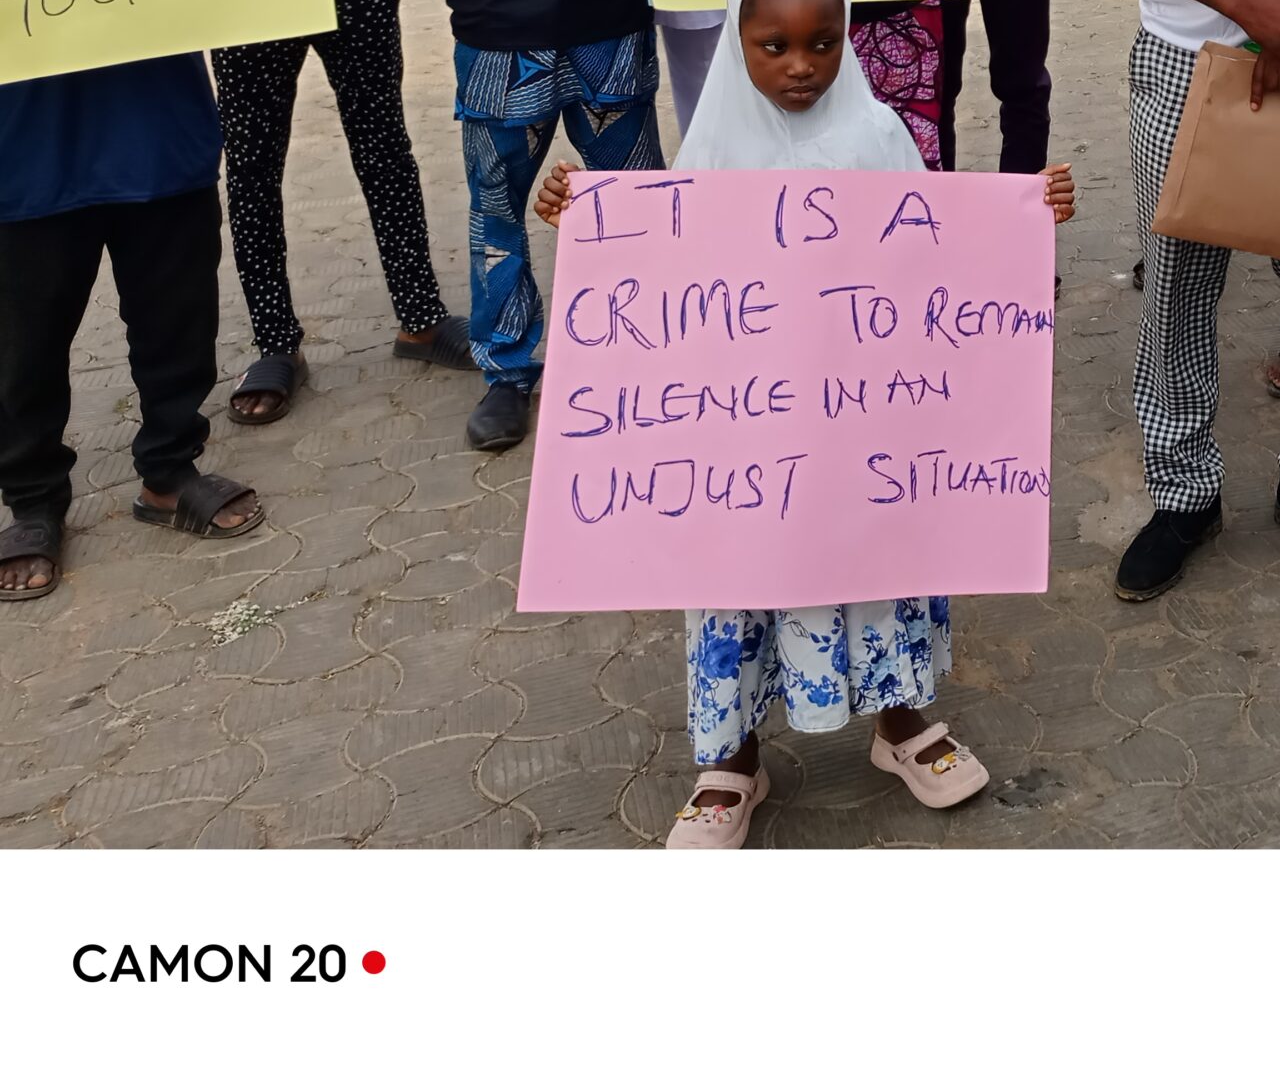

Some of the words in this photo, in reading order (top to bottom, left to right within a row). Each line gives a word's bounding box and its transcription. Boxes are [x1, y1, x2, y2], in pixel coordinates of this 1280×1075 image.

[570, 177, 695, 243] IT
[774, 184, 839, 248] IS
[879, 191, 942, 245] A
[565, 279, 778, 349] CRIME
[819, 285, 898, 343] TO
[561, 375, 795, 438] SILENCE
[824, 377, 867, 419] IN
[887, 369, 950, 405] AN
[570, 453, 808, 523] UNJUST
[867, 450, 1050, 504] SITUATION
